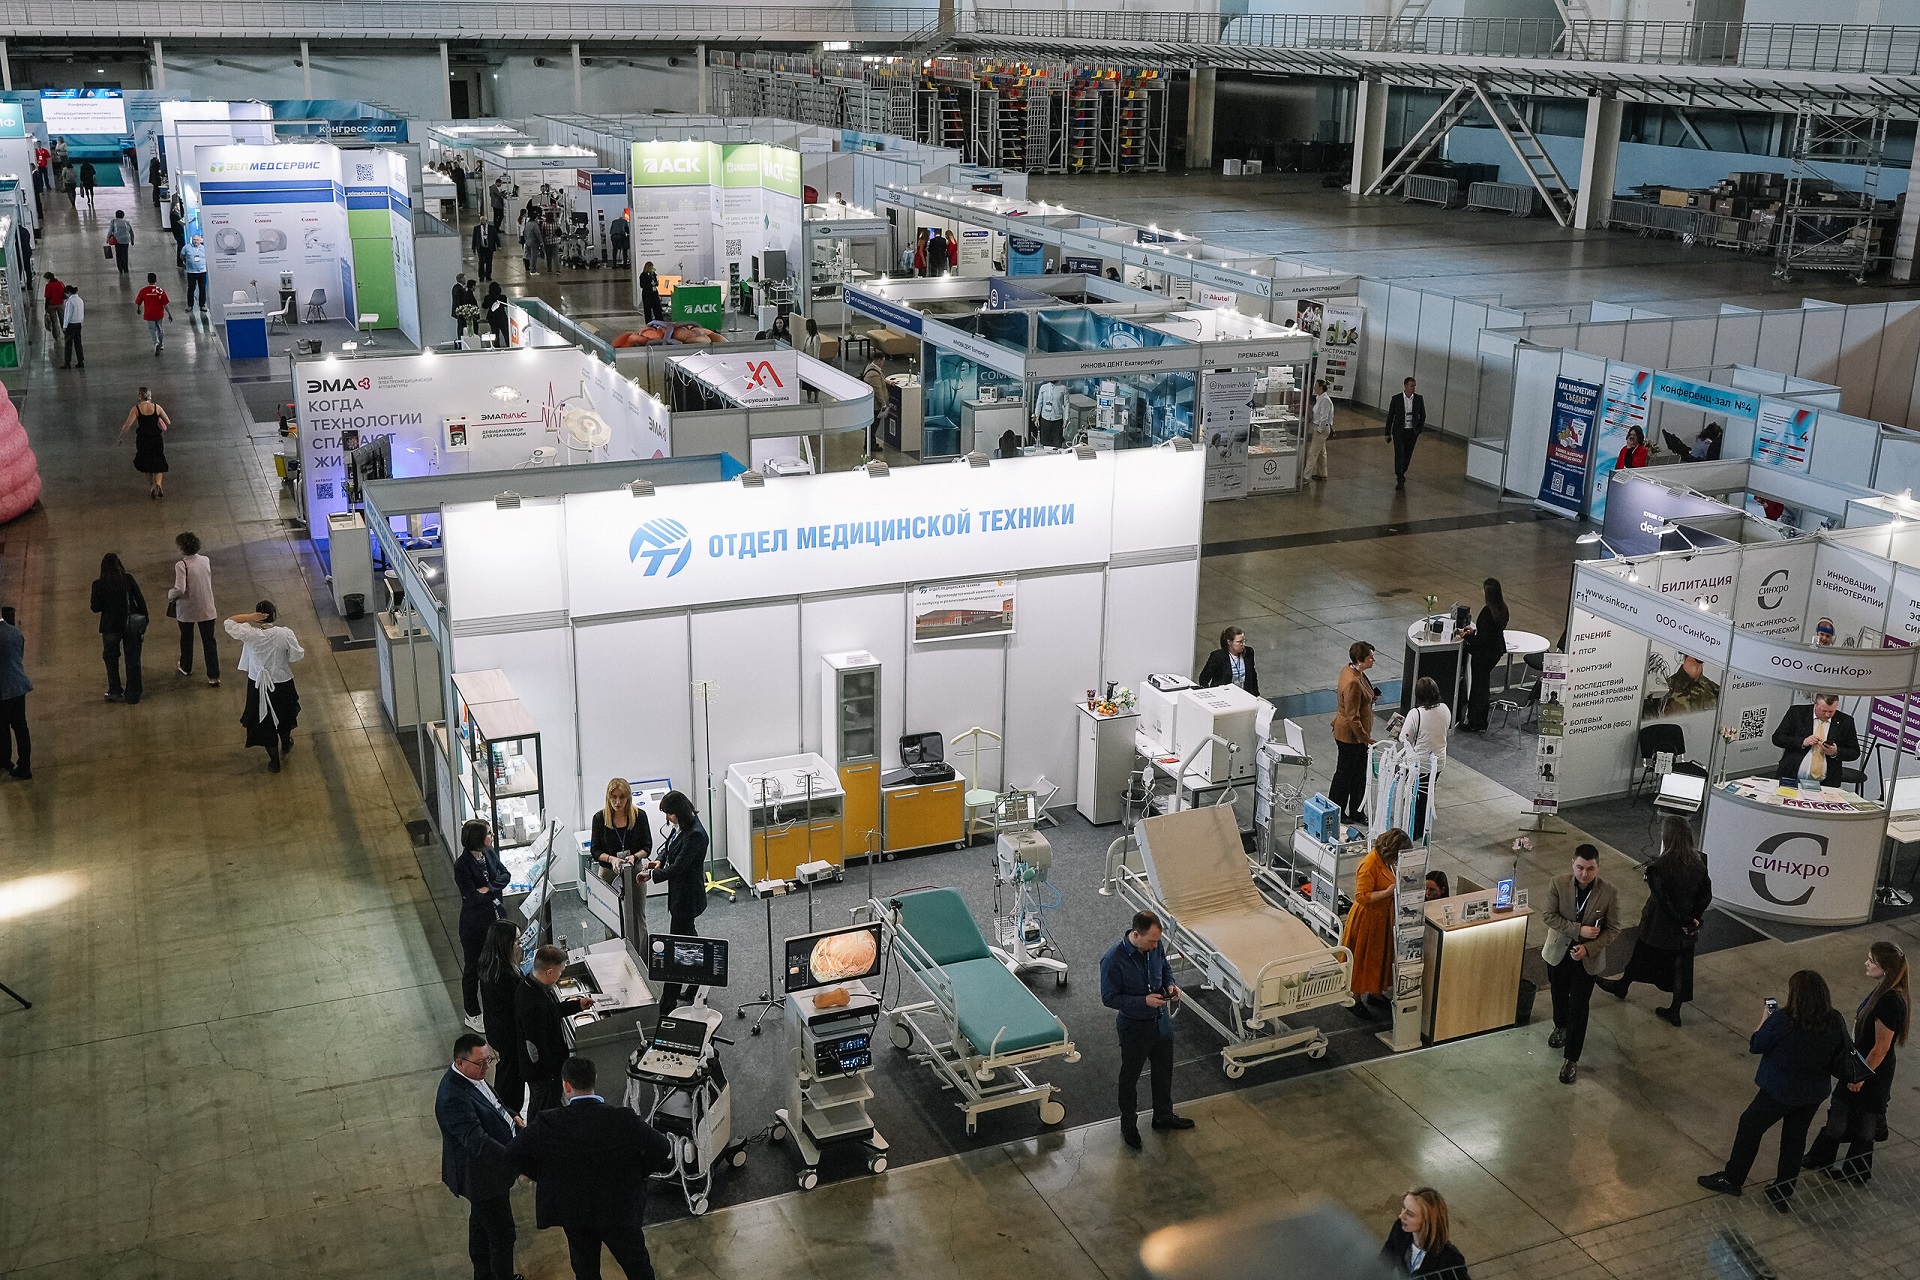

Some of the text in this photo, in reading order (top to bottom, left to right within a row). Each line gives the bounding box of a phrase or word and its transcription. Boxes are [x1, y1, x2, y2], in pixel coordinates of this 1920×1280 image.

[319, 125, 397, 134] конгресс-холл
[1209, 294, 1230, 302] Akutol
[694, 304, 718, 313] АСК
[1237, 351, 1279, 359] ПРЕМЬЕР-МЕД
[1320, 347, 1357, 356] ЭКСТРАКТЫ
[1124, 359, 1164, 367] Екатеринбург
[307, 378, 358, 394] ЭМА
[1558, 382, 1569, 390] КАК
[1568, 384, 1598, 397] МАРКЕТИНГ
[1640, 391, 1648, 402] 4
[1660, 384, 1731, 408] конференц-зал
[1734, 400, 1752, 412] №4
[308, 398, 364, 413] КОГДА
[310, 412, 422, 431] ТЕХНОЛОГИИ
[482, 427, 524, 435] ДЕФИБРИЛЛЯТОР
[493, 431, 527, 439] РЕАНИМАЦИИ
[1800, 431, 1809, 442] 4
[312, 432, 397, 450] СПААЮТ
[708, 503, 1075, 560] ОТДЕЛ МЕДИЦИНСКОЙ ТЕХНИКИ
[1661, 575, 1732, 593] БИЛИТАЦИЯ
[1827, 569, 1877, 594] ИННОВАЦИИ
[1576, 591, 1588, 602] F11
[1585, 587, 1638, 614] www.sinkor.ru
[1816, 578, 1884, 609] В НЕЙРОТЕРАПИИ
[1574, 630, 1612, 642] ЛЕЧЕНИЕ
[1656, 613, 1721, 647] ООО «СинКор»
[1576, 662, 1612, 673] КОНТУЗИЙ
[1771, 656, 1872, 678] ООО «СинКор»
[1574, 677, 1624, 691] ПОСЛЕДСТВИЙ
[1573, 684, 1639, 700] МИННО-ВЗРЫВНЫХ
[1572, 694, 1634, 708] РАНЕНИЙ ГОЛОВЫ
[1568, 720, 1632, 735] СИНДРОМОВ (ФБС)
[1569, 716, 1603, 726] БОЛЕВЫХ
